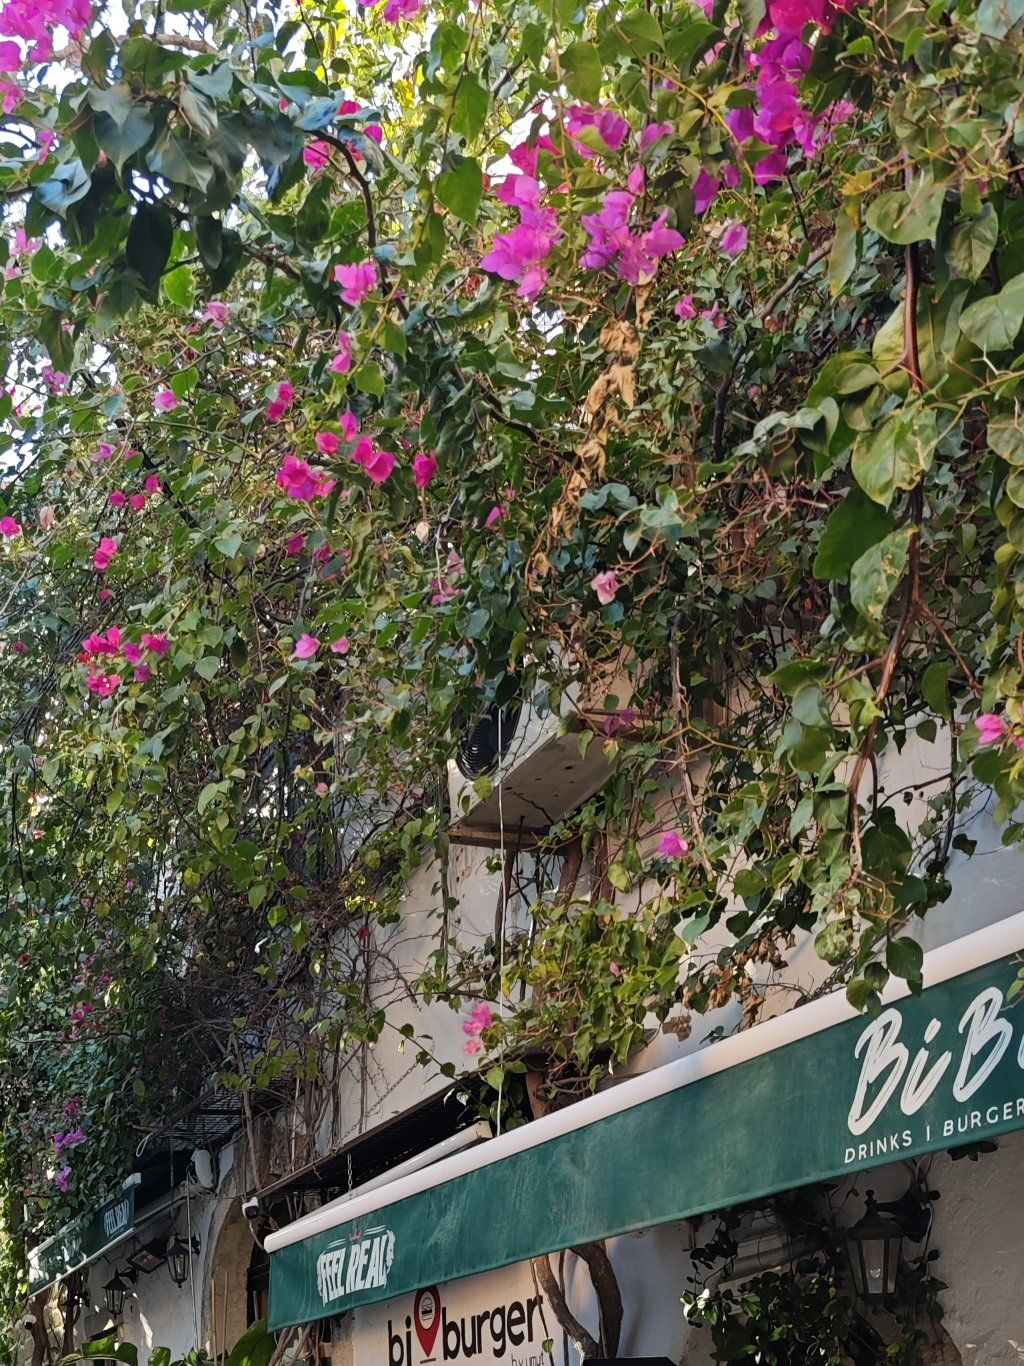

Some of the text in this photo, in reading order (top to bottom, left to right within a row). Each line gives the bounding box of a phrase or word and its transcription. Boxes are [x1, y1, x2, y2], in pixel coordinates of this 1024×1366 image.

[848, 987, 1024, 1136] BiB
[844, 1130, 913, 1164] DRINKS
[319, 1234, 389, 1307] FEEL REAL
[441, 1295, 544, 1361] burger
